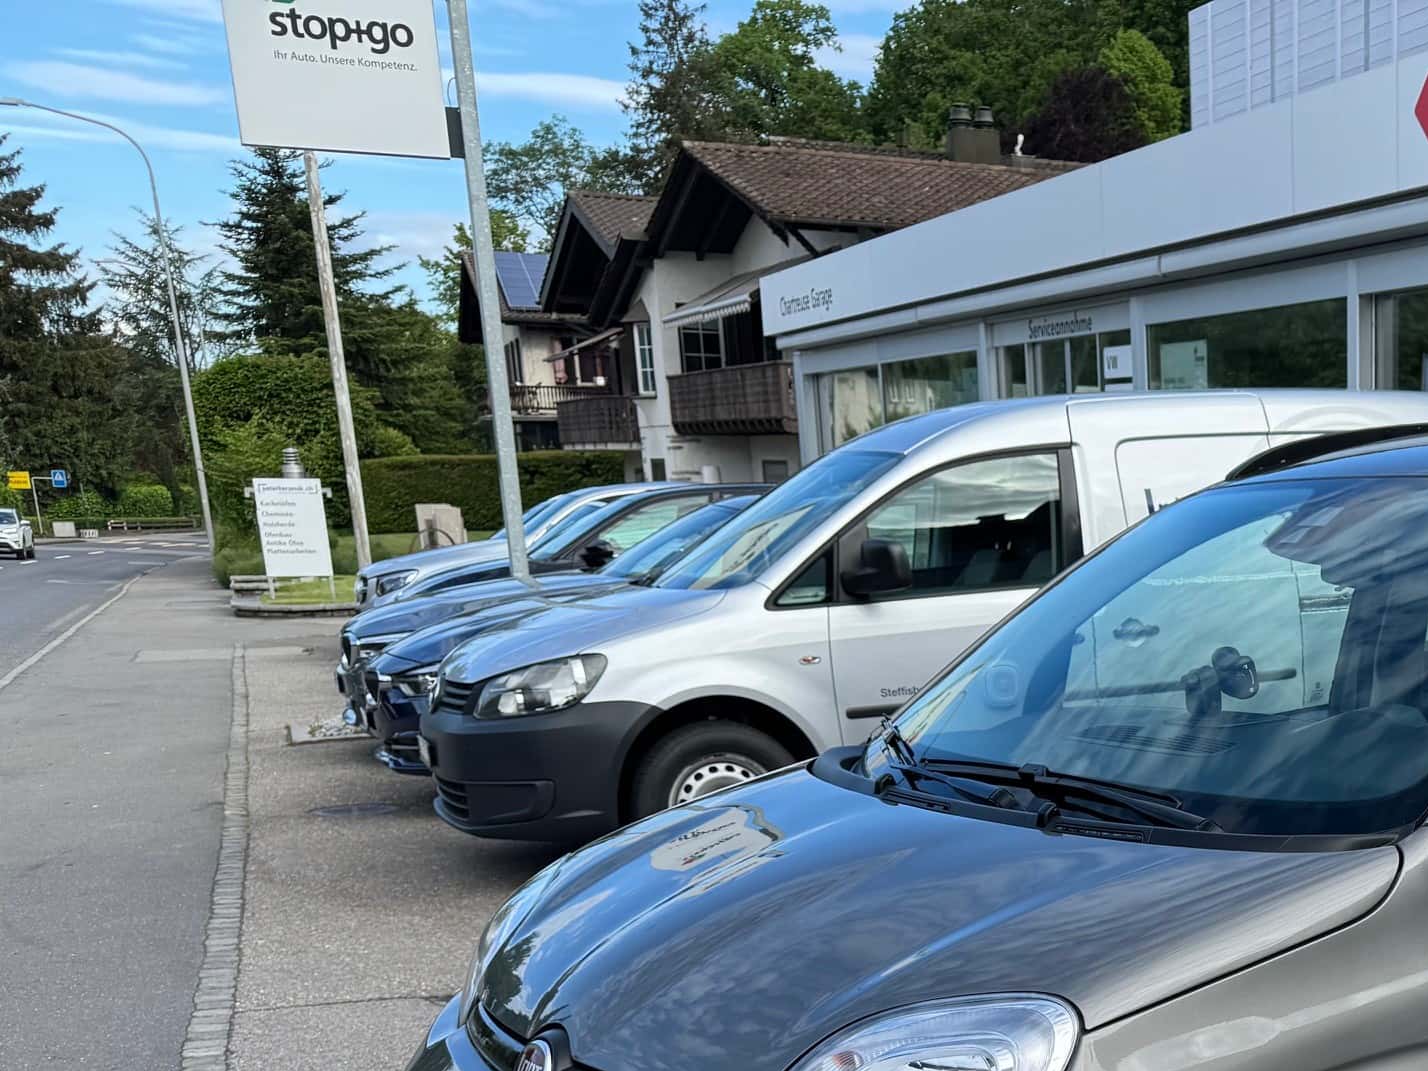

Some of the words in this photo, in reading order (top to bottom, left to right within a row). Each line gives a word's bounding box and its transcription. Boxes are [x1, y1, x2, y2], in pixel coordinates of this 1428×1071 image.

[268, 7, 414, 54] stop+go
[273, 50, 288, 60] Ihr
[290, 51, 318, 63] Auto.
[320, 54, 356, 67] Unsere
[357, 57, 418, 72] Kompetenz.
[810, 287, 833, 311] Garage
[880, 686, 922, 698] Steffisb
